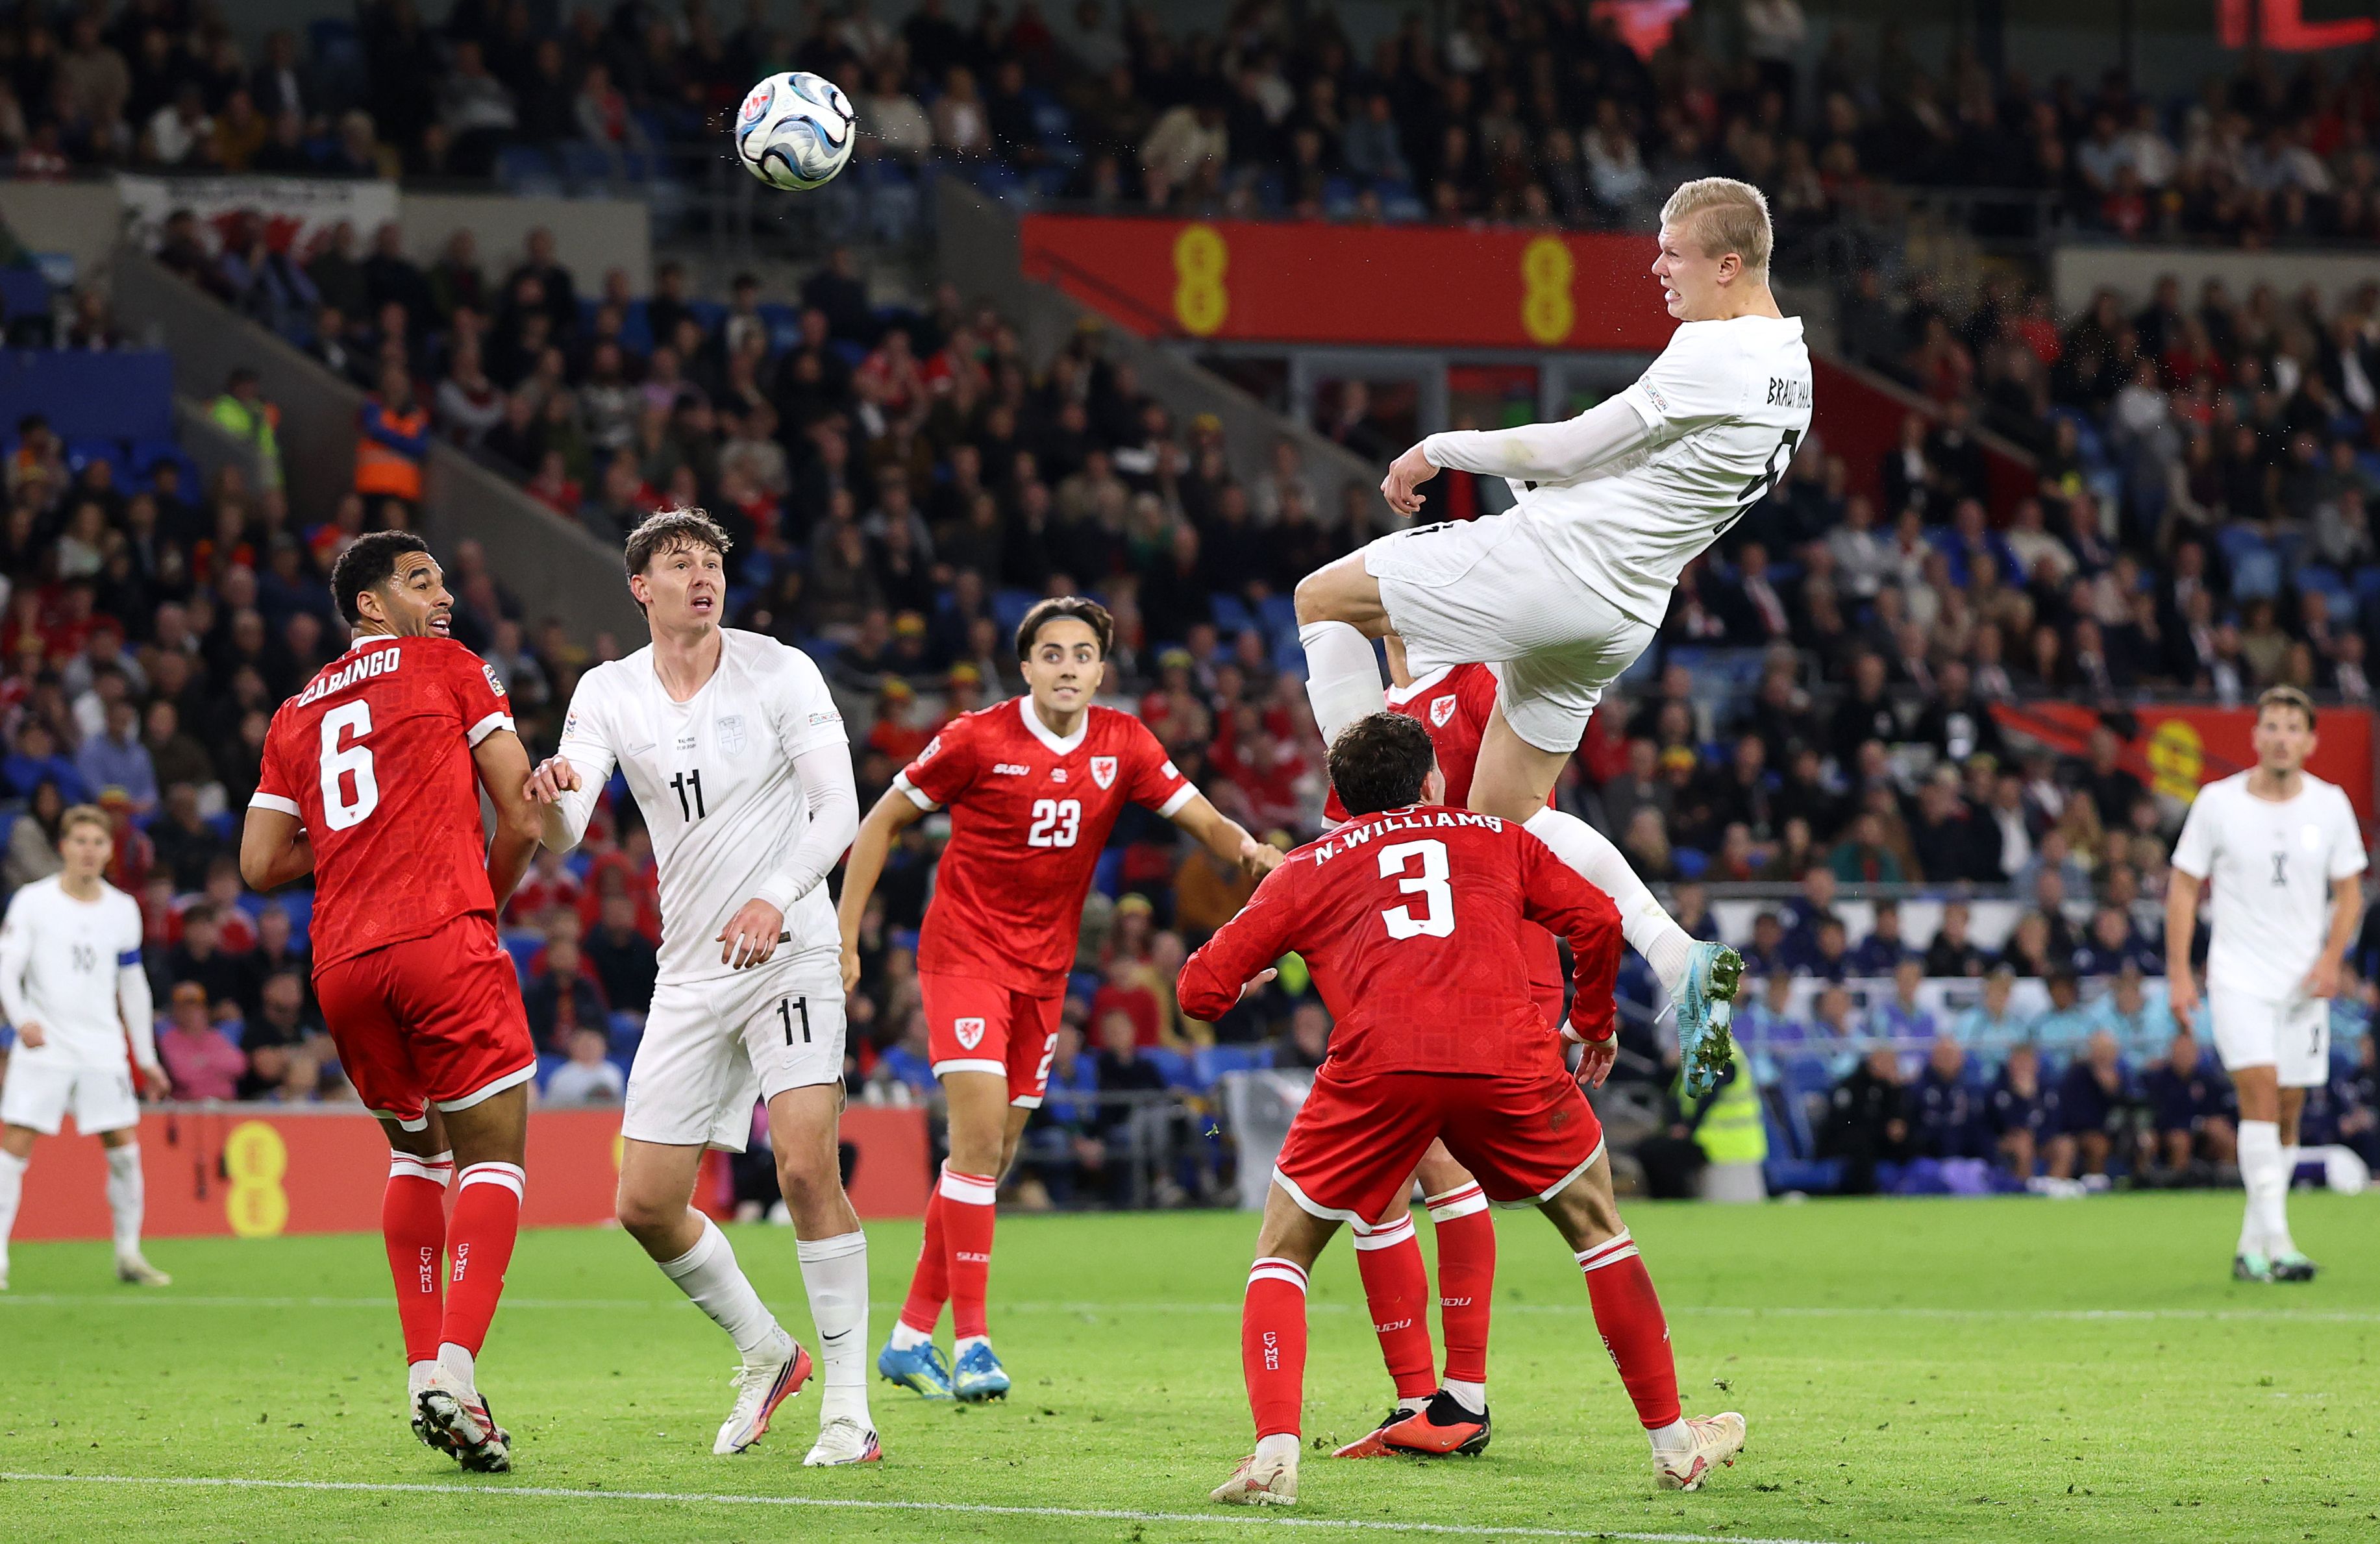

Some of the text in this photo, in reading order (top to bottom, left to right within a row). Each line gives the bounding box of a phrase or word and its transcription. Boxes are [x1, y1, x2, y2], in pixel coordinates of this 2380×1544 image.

[1766, 376, 1796, 408] BRAUT
[297, 647, 401, 707] CABANGO
[319, 698, 380, 832] 6
[670, 769, 706, 822] 11
[1028, 798, 1082, 848] 23
[1315, 813, 1503, 867] N.WILLIAMS
[1377, 839, 1456, 940] 3
[776, 996, 812, 1046] 11
[1035, 1032, 1060, 1080] 2
[419, 1246, 433, 1293] CYMRU
[453, 1243, 469, 1282] CYMRU
[1263, 1331, 1279, 1370] CYMRU
